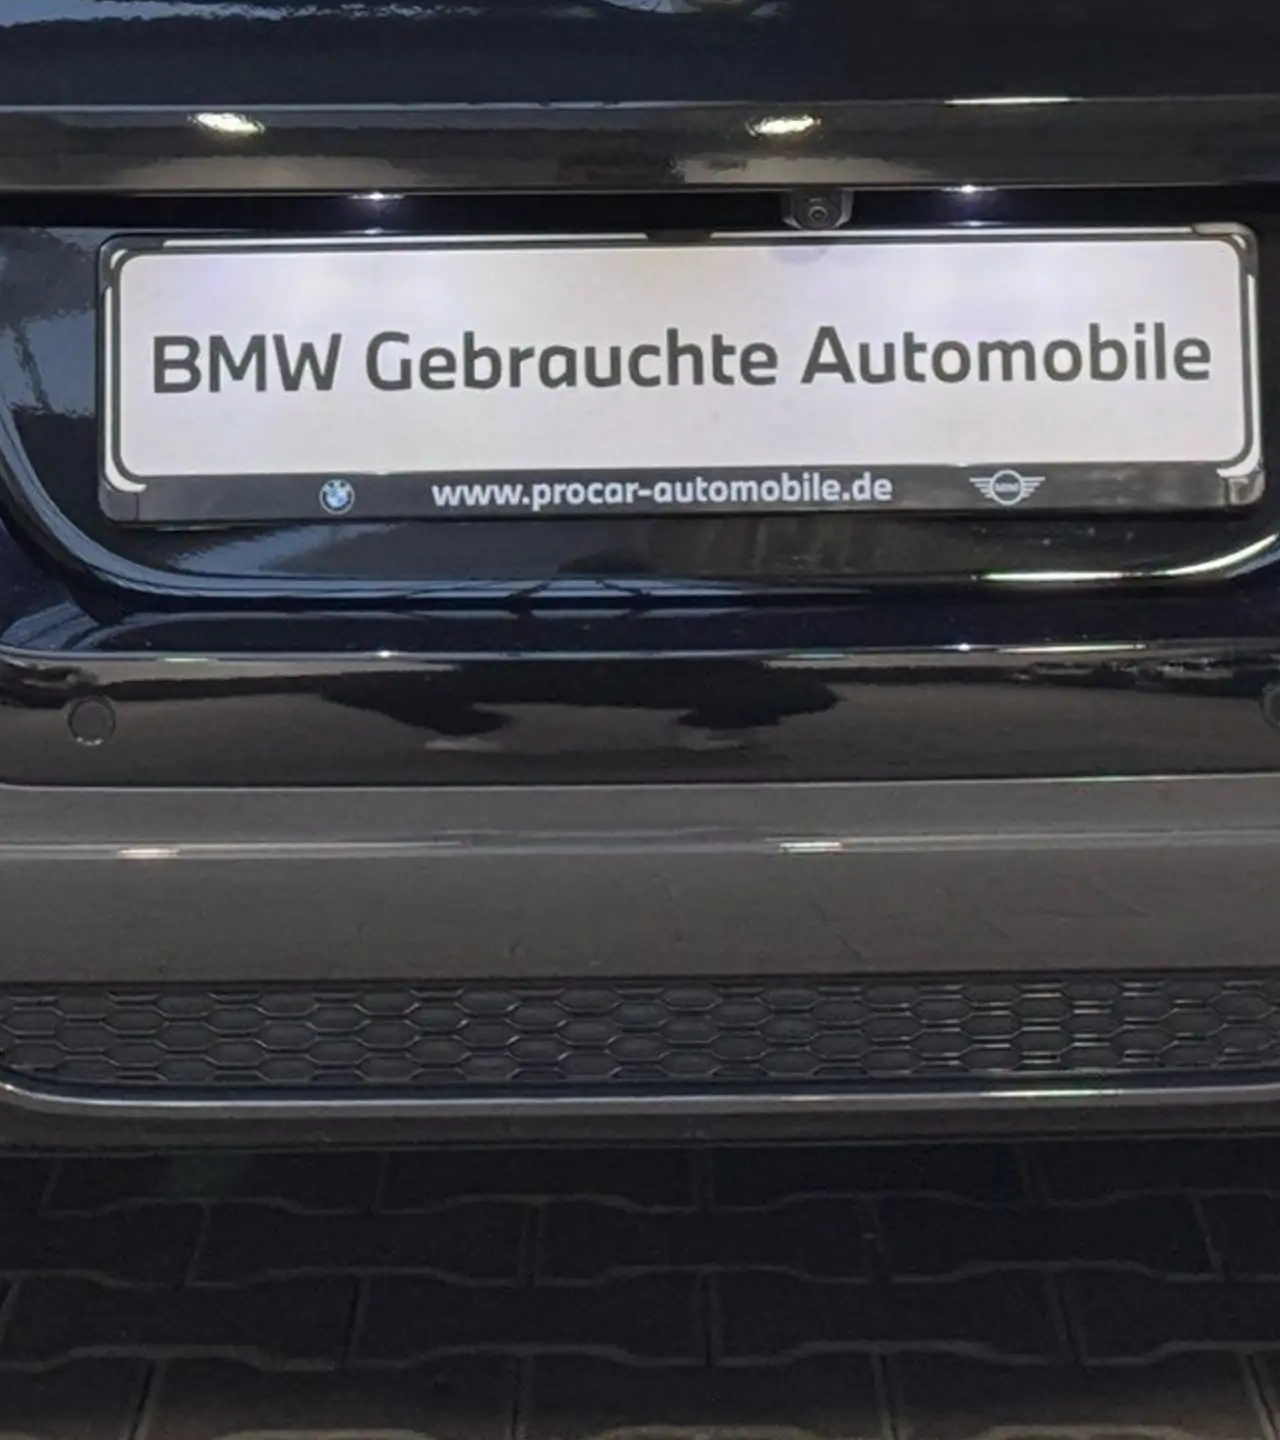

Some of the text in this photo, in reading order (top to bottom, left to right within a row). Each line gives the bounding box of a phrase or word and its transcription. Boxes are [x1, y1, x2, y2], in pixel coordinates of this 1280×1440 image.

[153, 322, 1211, 394] BMW Gebrauchte Automobile
[430, 470, 894, 512] www.procar-automobile.de
